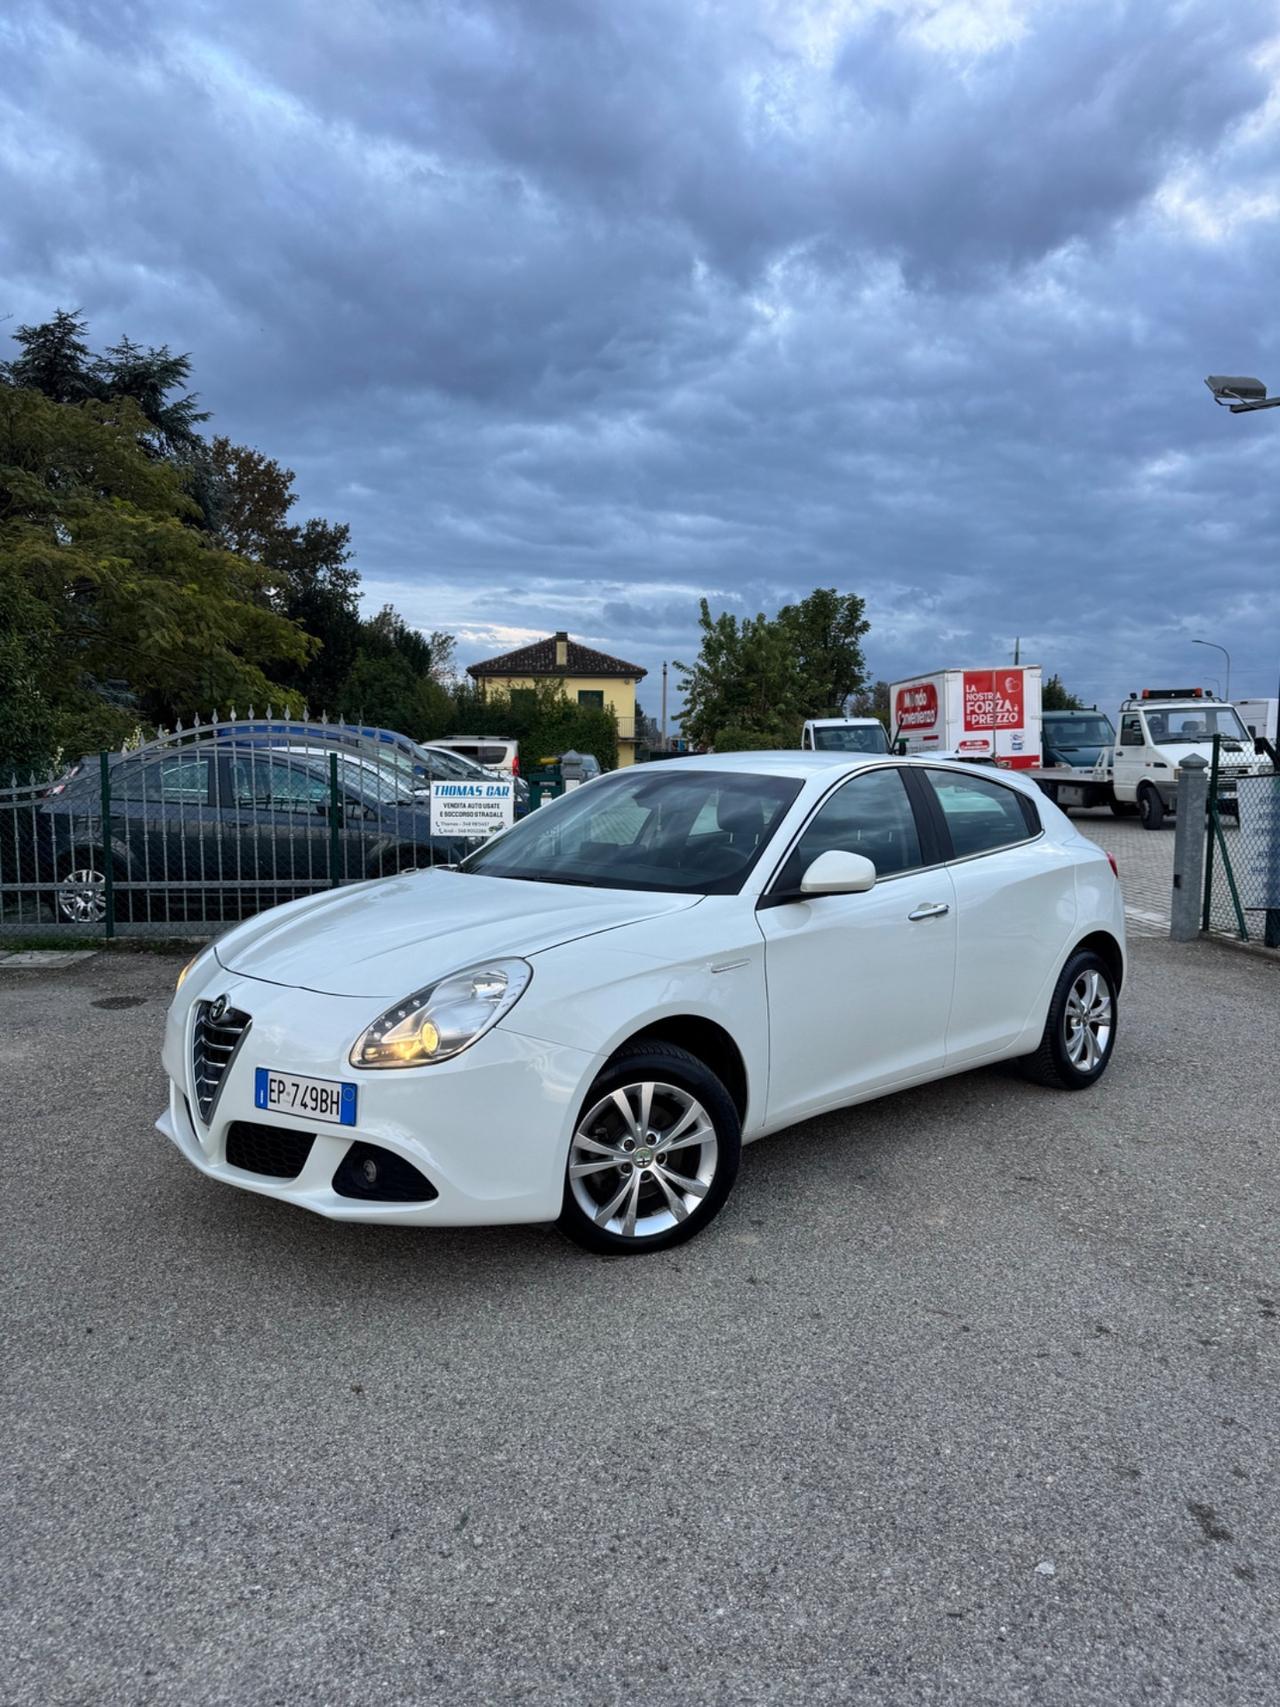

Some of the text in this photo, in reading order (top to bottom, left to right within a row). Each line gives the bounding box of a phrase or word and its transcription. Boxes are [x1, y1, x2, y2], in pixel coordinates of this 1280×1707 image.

[966, 692, 1001, 701] NOSTRA
[966, 699, 1012, 714] FORZA
[972, 712, 1018, 724] PREZZO
[434, 785, 510, 796] THOMAS CAR
